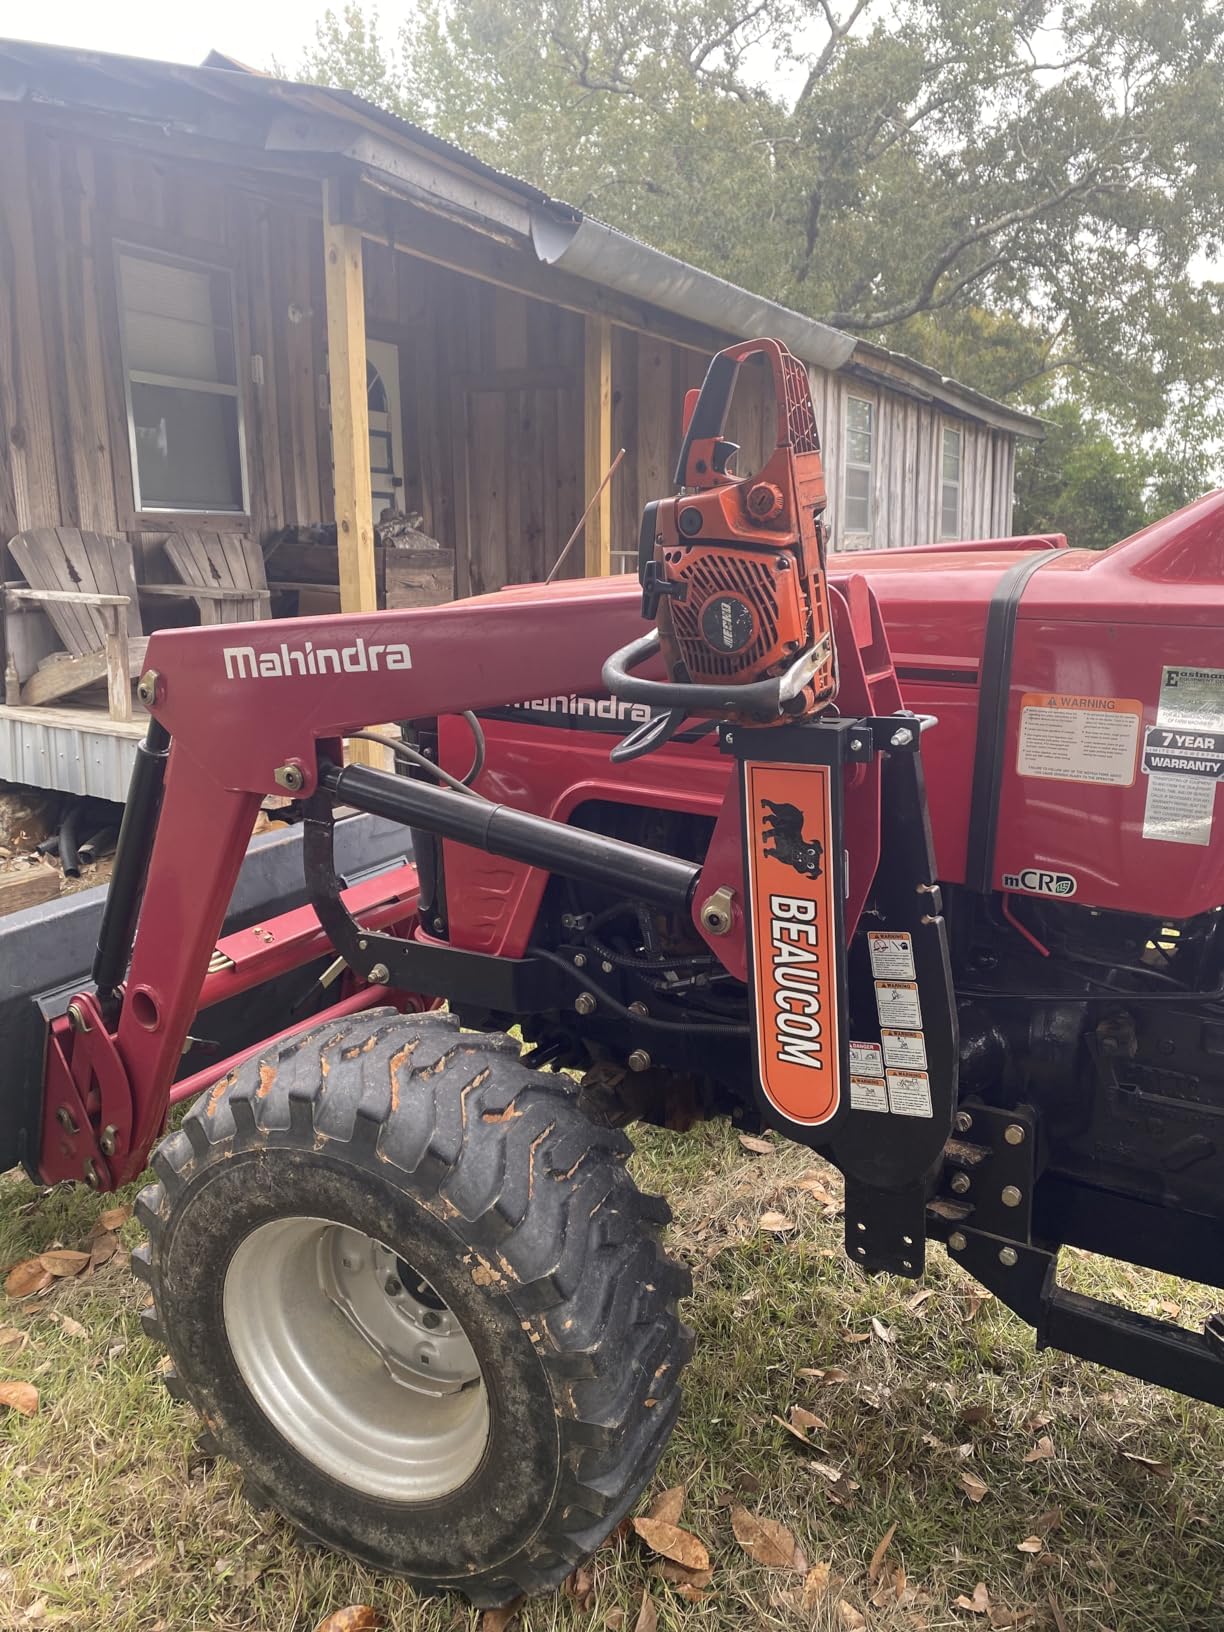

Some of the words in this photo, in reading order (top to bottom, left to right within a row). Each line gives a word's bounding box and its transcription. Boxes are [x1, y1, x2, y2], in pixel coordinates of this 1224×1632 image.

[223, 638, 412, 679] Mahindra
[1060, 697, 1115, 710] WARNING
[1162, 732, 1173, 746] 7
[1175, 735, 1215, 749] YEAR
[1151, 757, 1221, 772] WARRANTY
[768, 893, 823, 1070] BEAUCOM
